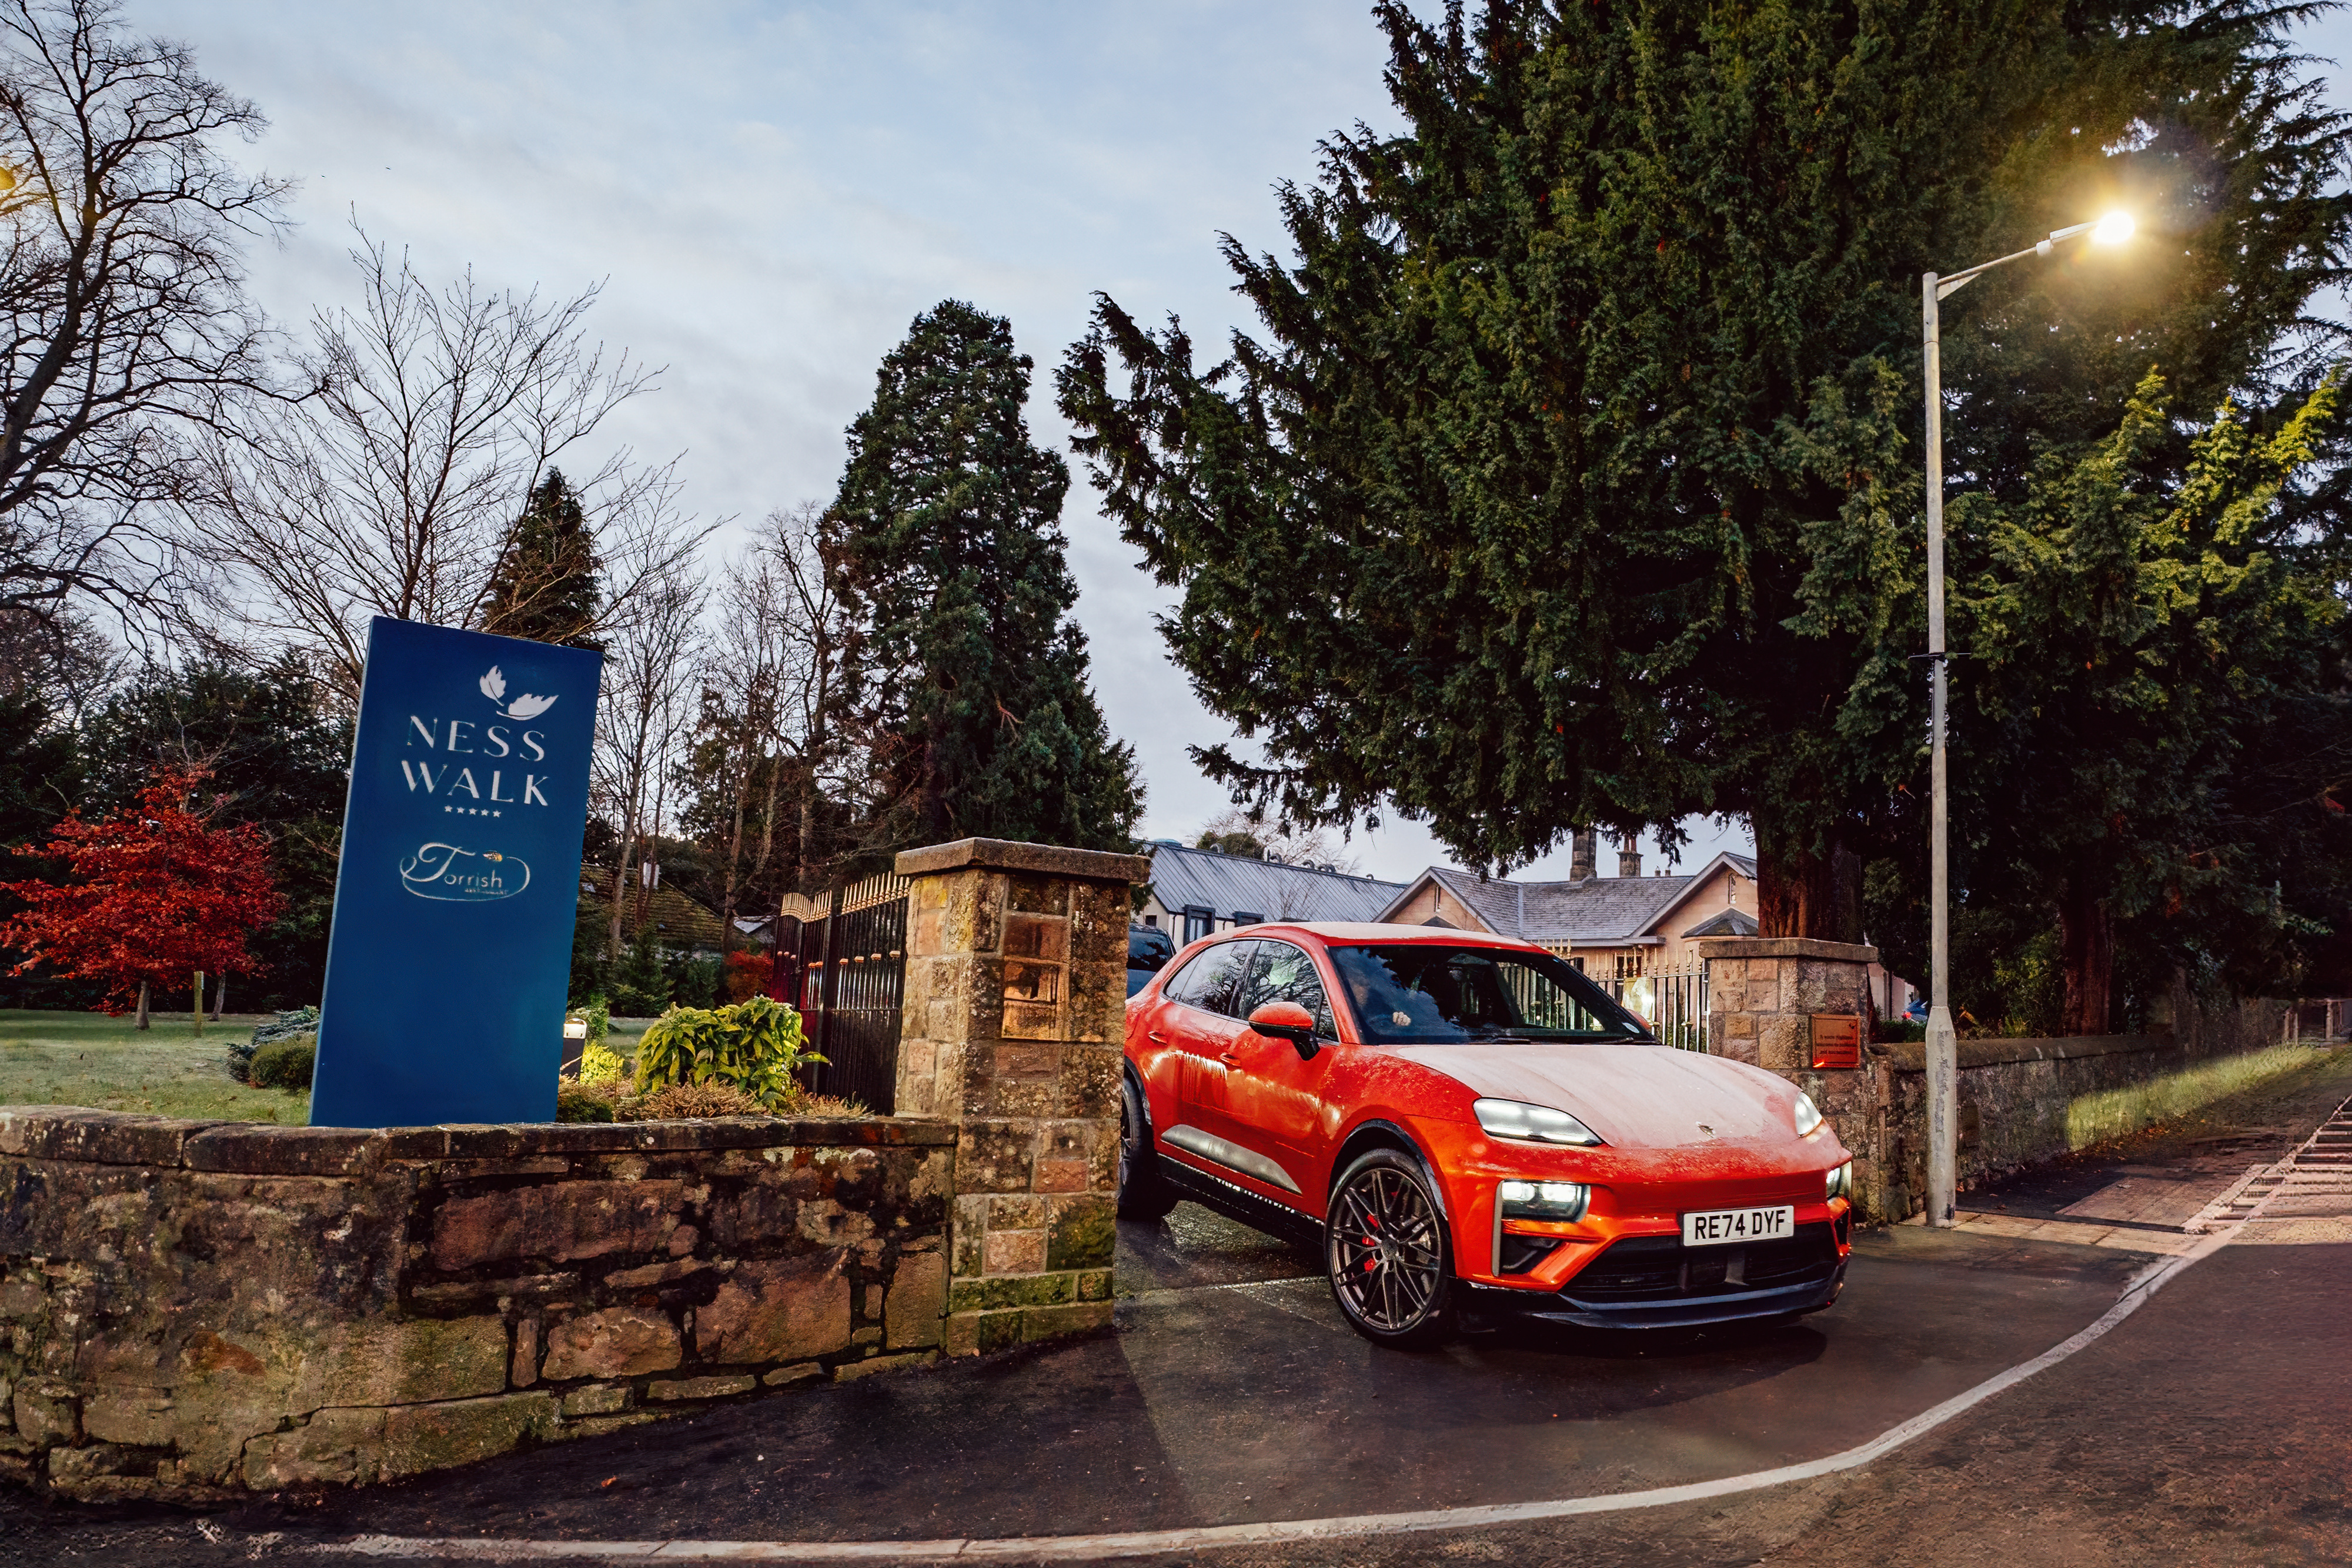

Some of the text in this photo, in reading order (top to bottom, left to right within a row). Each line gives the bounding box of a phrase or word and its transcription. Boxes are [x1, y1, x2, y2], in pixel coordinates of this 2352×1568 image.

[407, 715, 545, 762] NESS
[401, 760, 549, 807] WALK
[400, 842, 503, 888] Torrish
[1695, 1209, 1786, 1240] RE74 DYF
